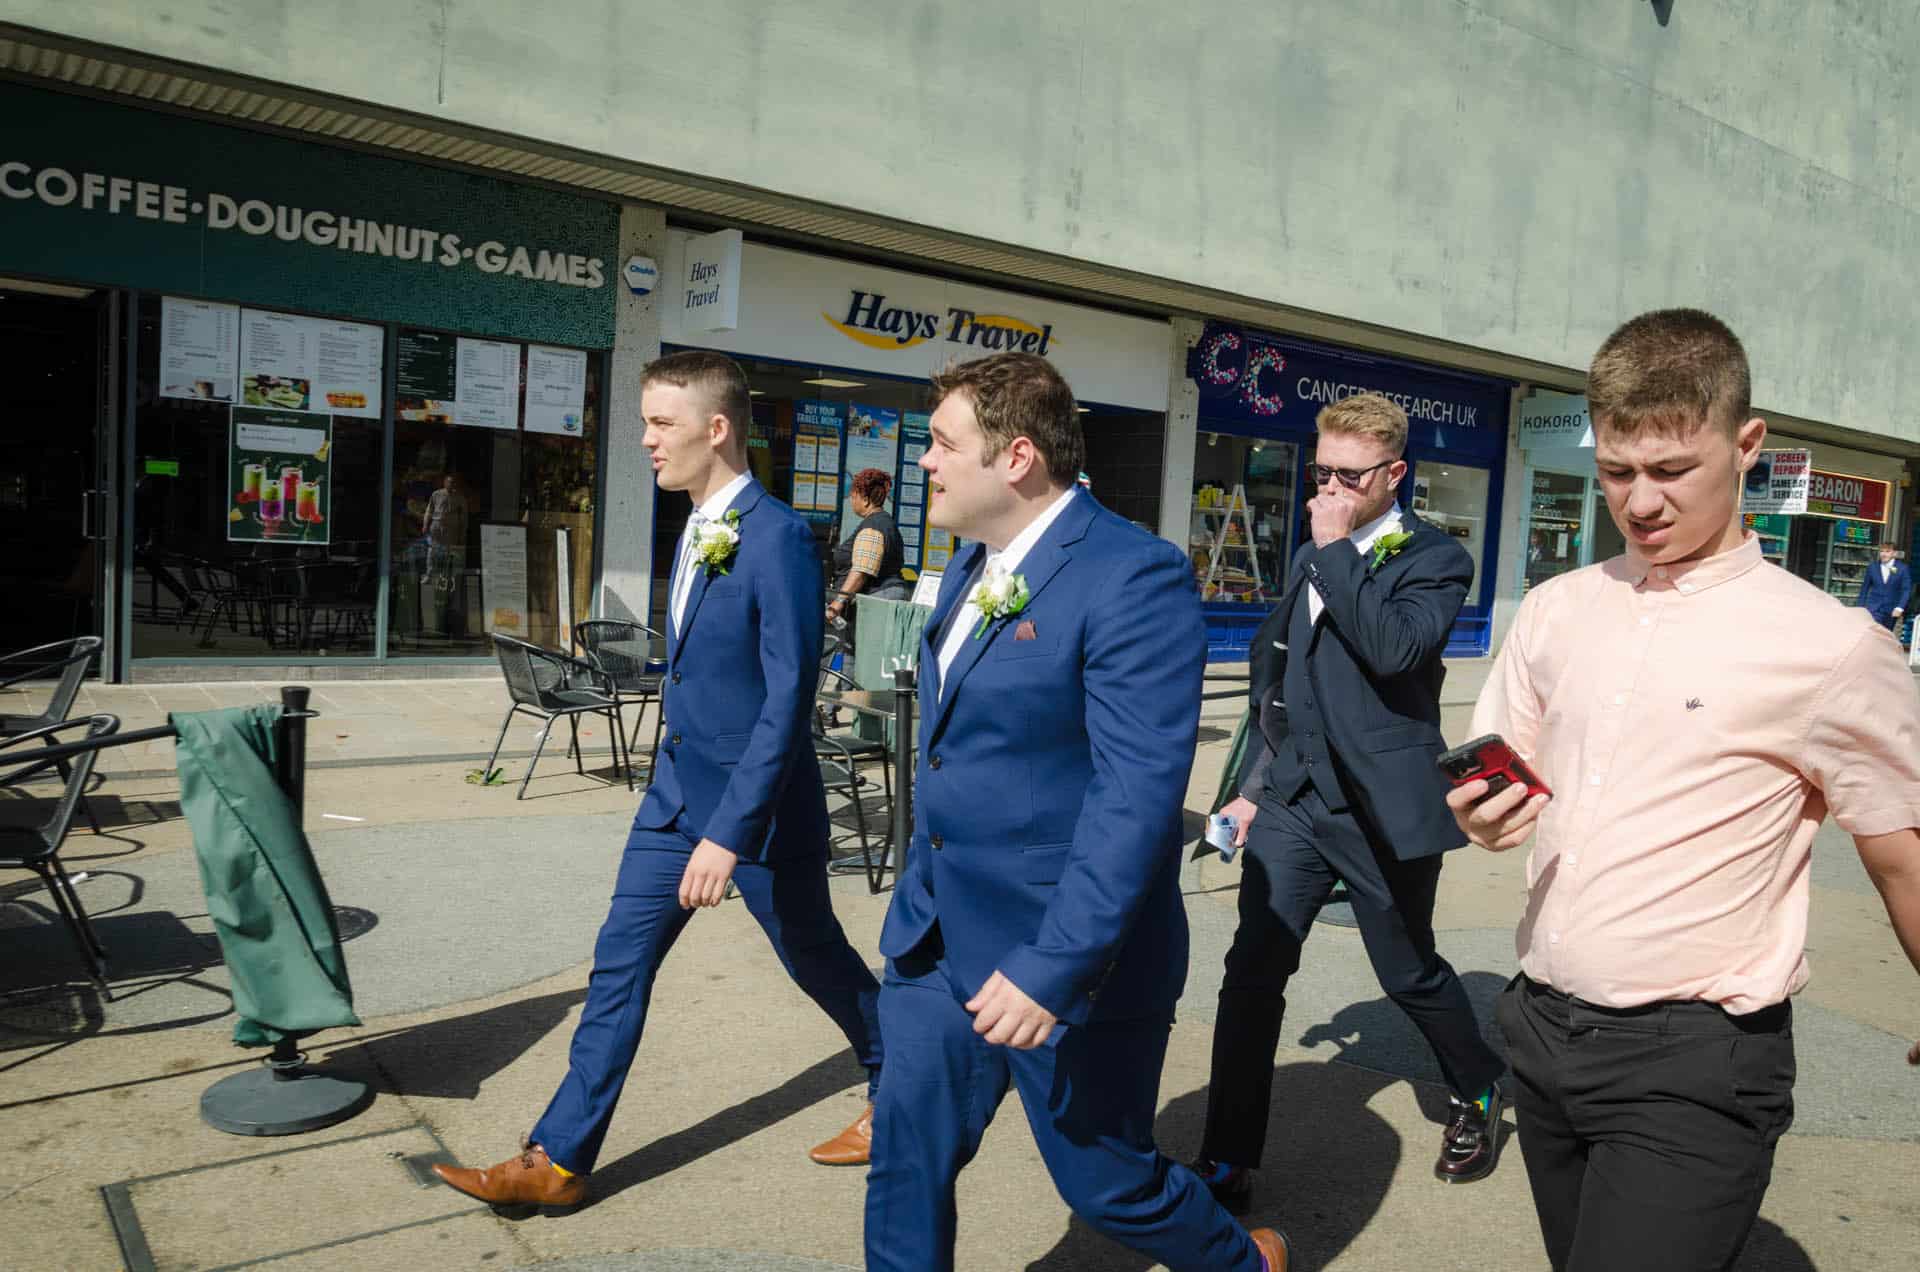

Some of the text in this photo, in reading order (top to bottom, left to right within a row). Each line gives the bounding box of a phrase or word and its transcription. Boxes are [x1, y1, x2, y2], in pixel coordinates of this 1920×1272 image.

[0, 161, 605, 288] COFFEE DOUGHNUTS GAMES
[688, 261, 718, 284] Hays
[685, 284, 720, 309] Travel
[843, 289, 1053, 356] Hays Travel
[1457, 405, 1478, 427] UK
[1523, 414, 1582, 429] KOKORO
[1775, 453, 1807, 463] SCREEN
[1773, 464, 1809, 475] REPAIRS
[1772, 490, 1804, 500] SERVICE
